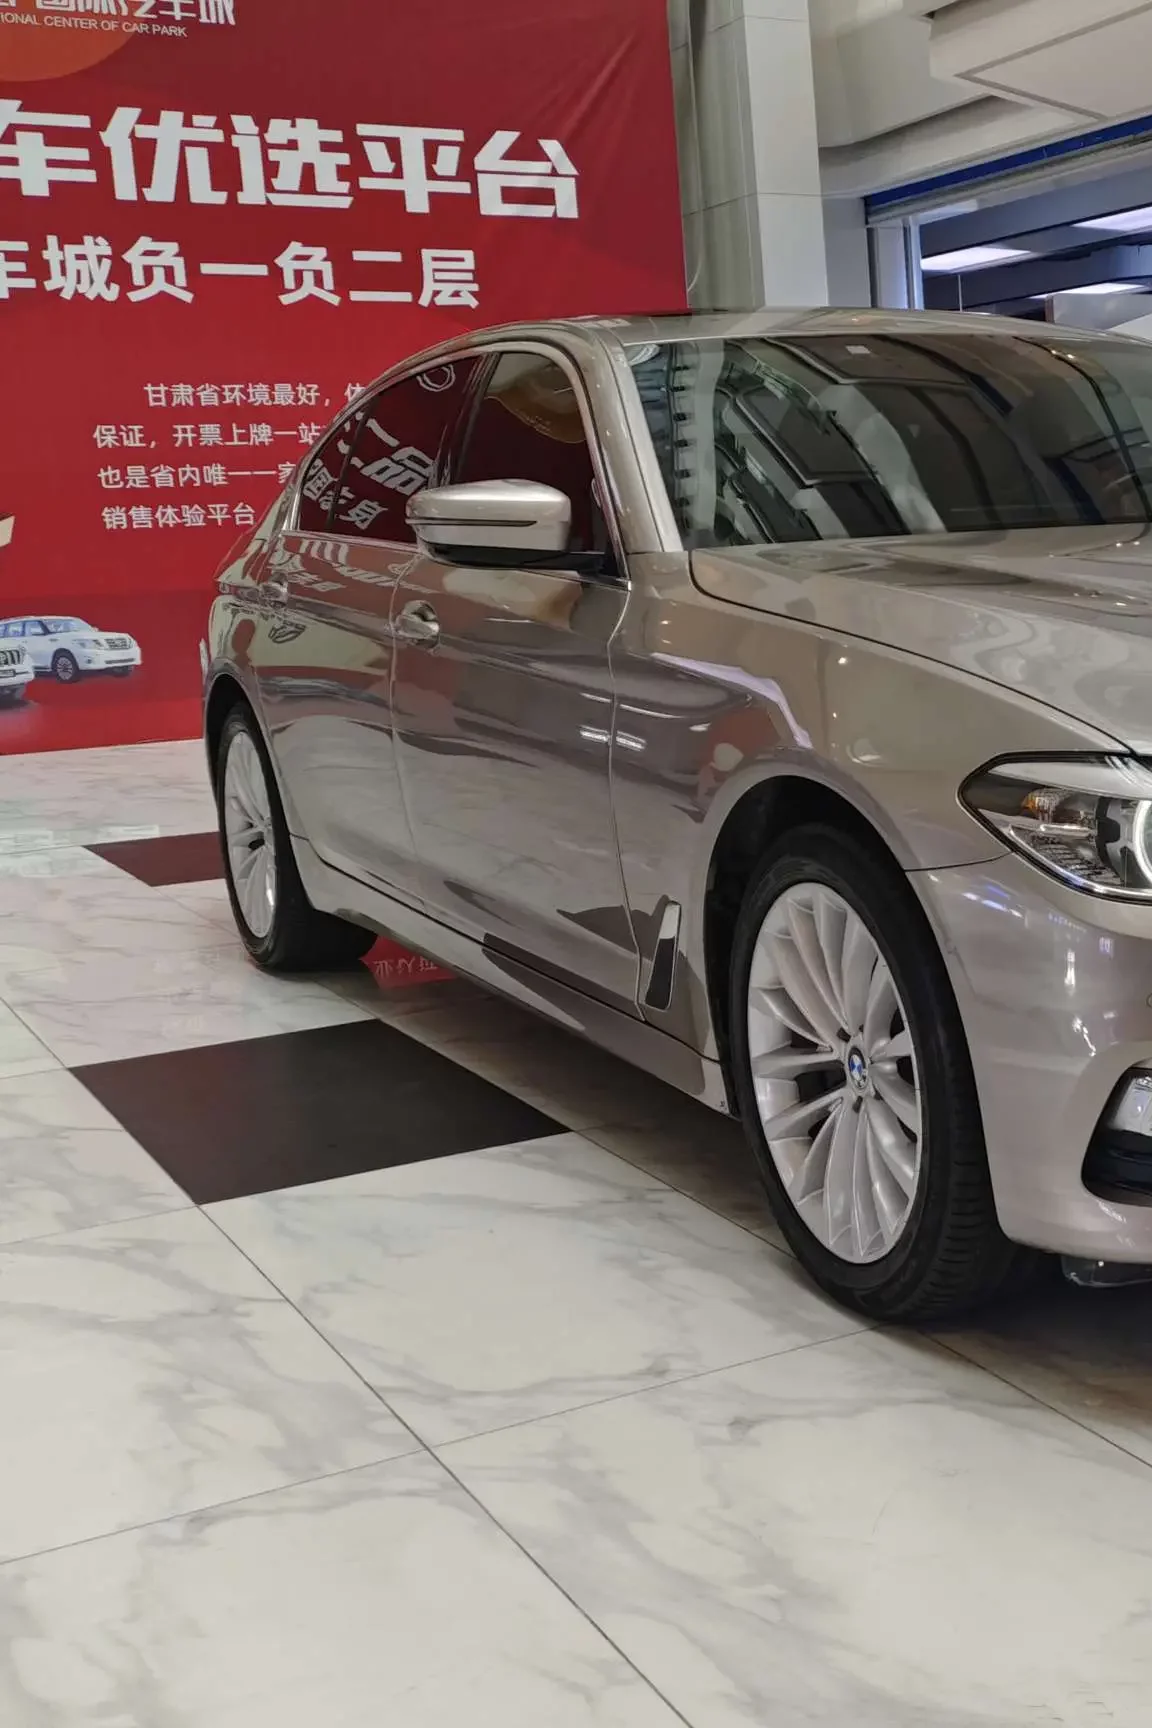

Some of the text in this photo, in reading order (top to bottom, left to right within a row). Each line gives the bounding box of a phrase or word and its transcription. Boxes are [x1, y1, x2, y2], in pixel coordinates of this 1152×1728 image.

[0, 12, 188, 38] IONAL CENTER OF CAR PARK
[0, 99, 580, 220] 车优选平台
[93, 422, 327, 449] 保证，开票上牌一站
[101, 501, 256, 530] 销售体验平台
